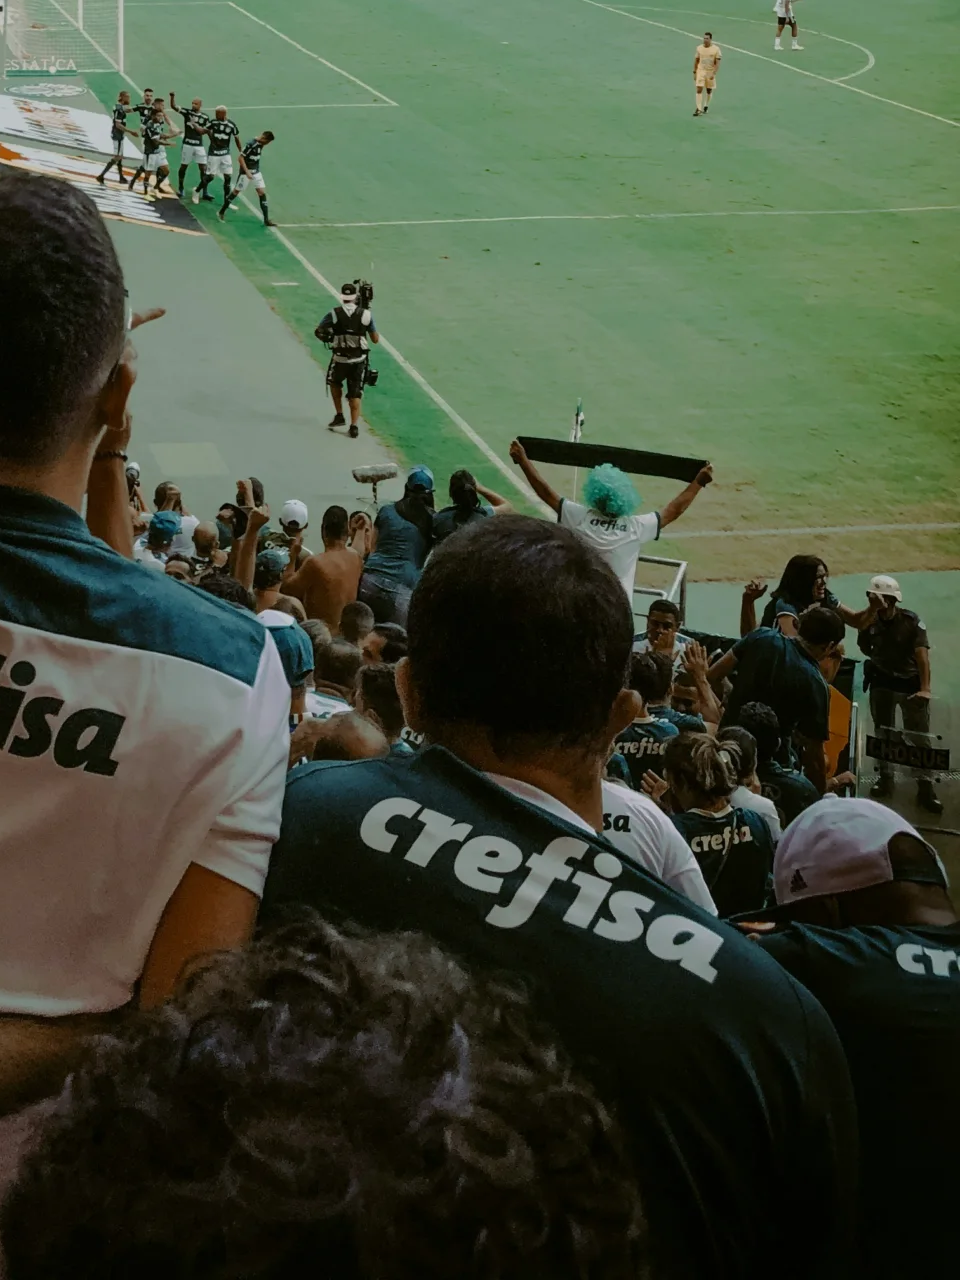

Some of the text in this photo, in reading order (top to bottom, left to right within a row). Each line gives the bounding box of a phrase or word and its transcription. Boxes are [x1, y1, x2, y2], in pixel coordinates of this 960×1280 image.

[868, 739, 946, 767] CHOQUE
[691, 825, 752, 855] crefsa
[359, 796, 724, 984] crefisa
